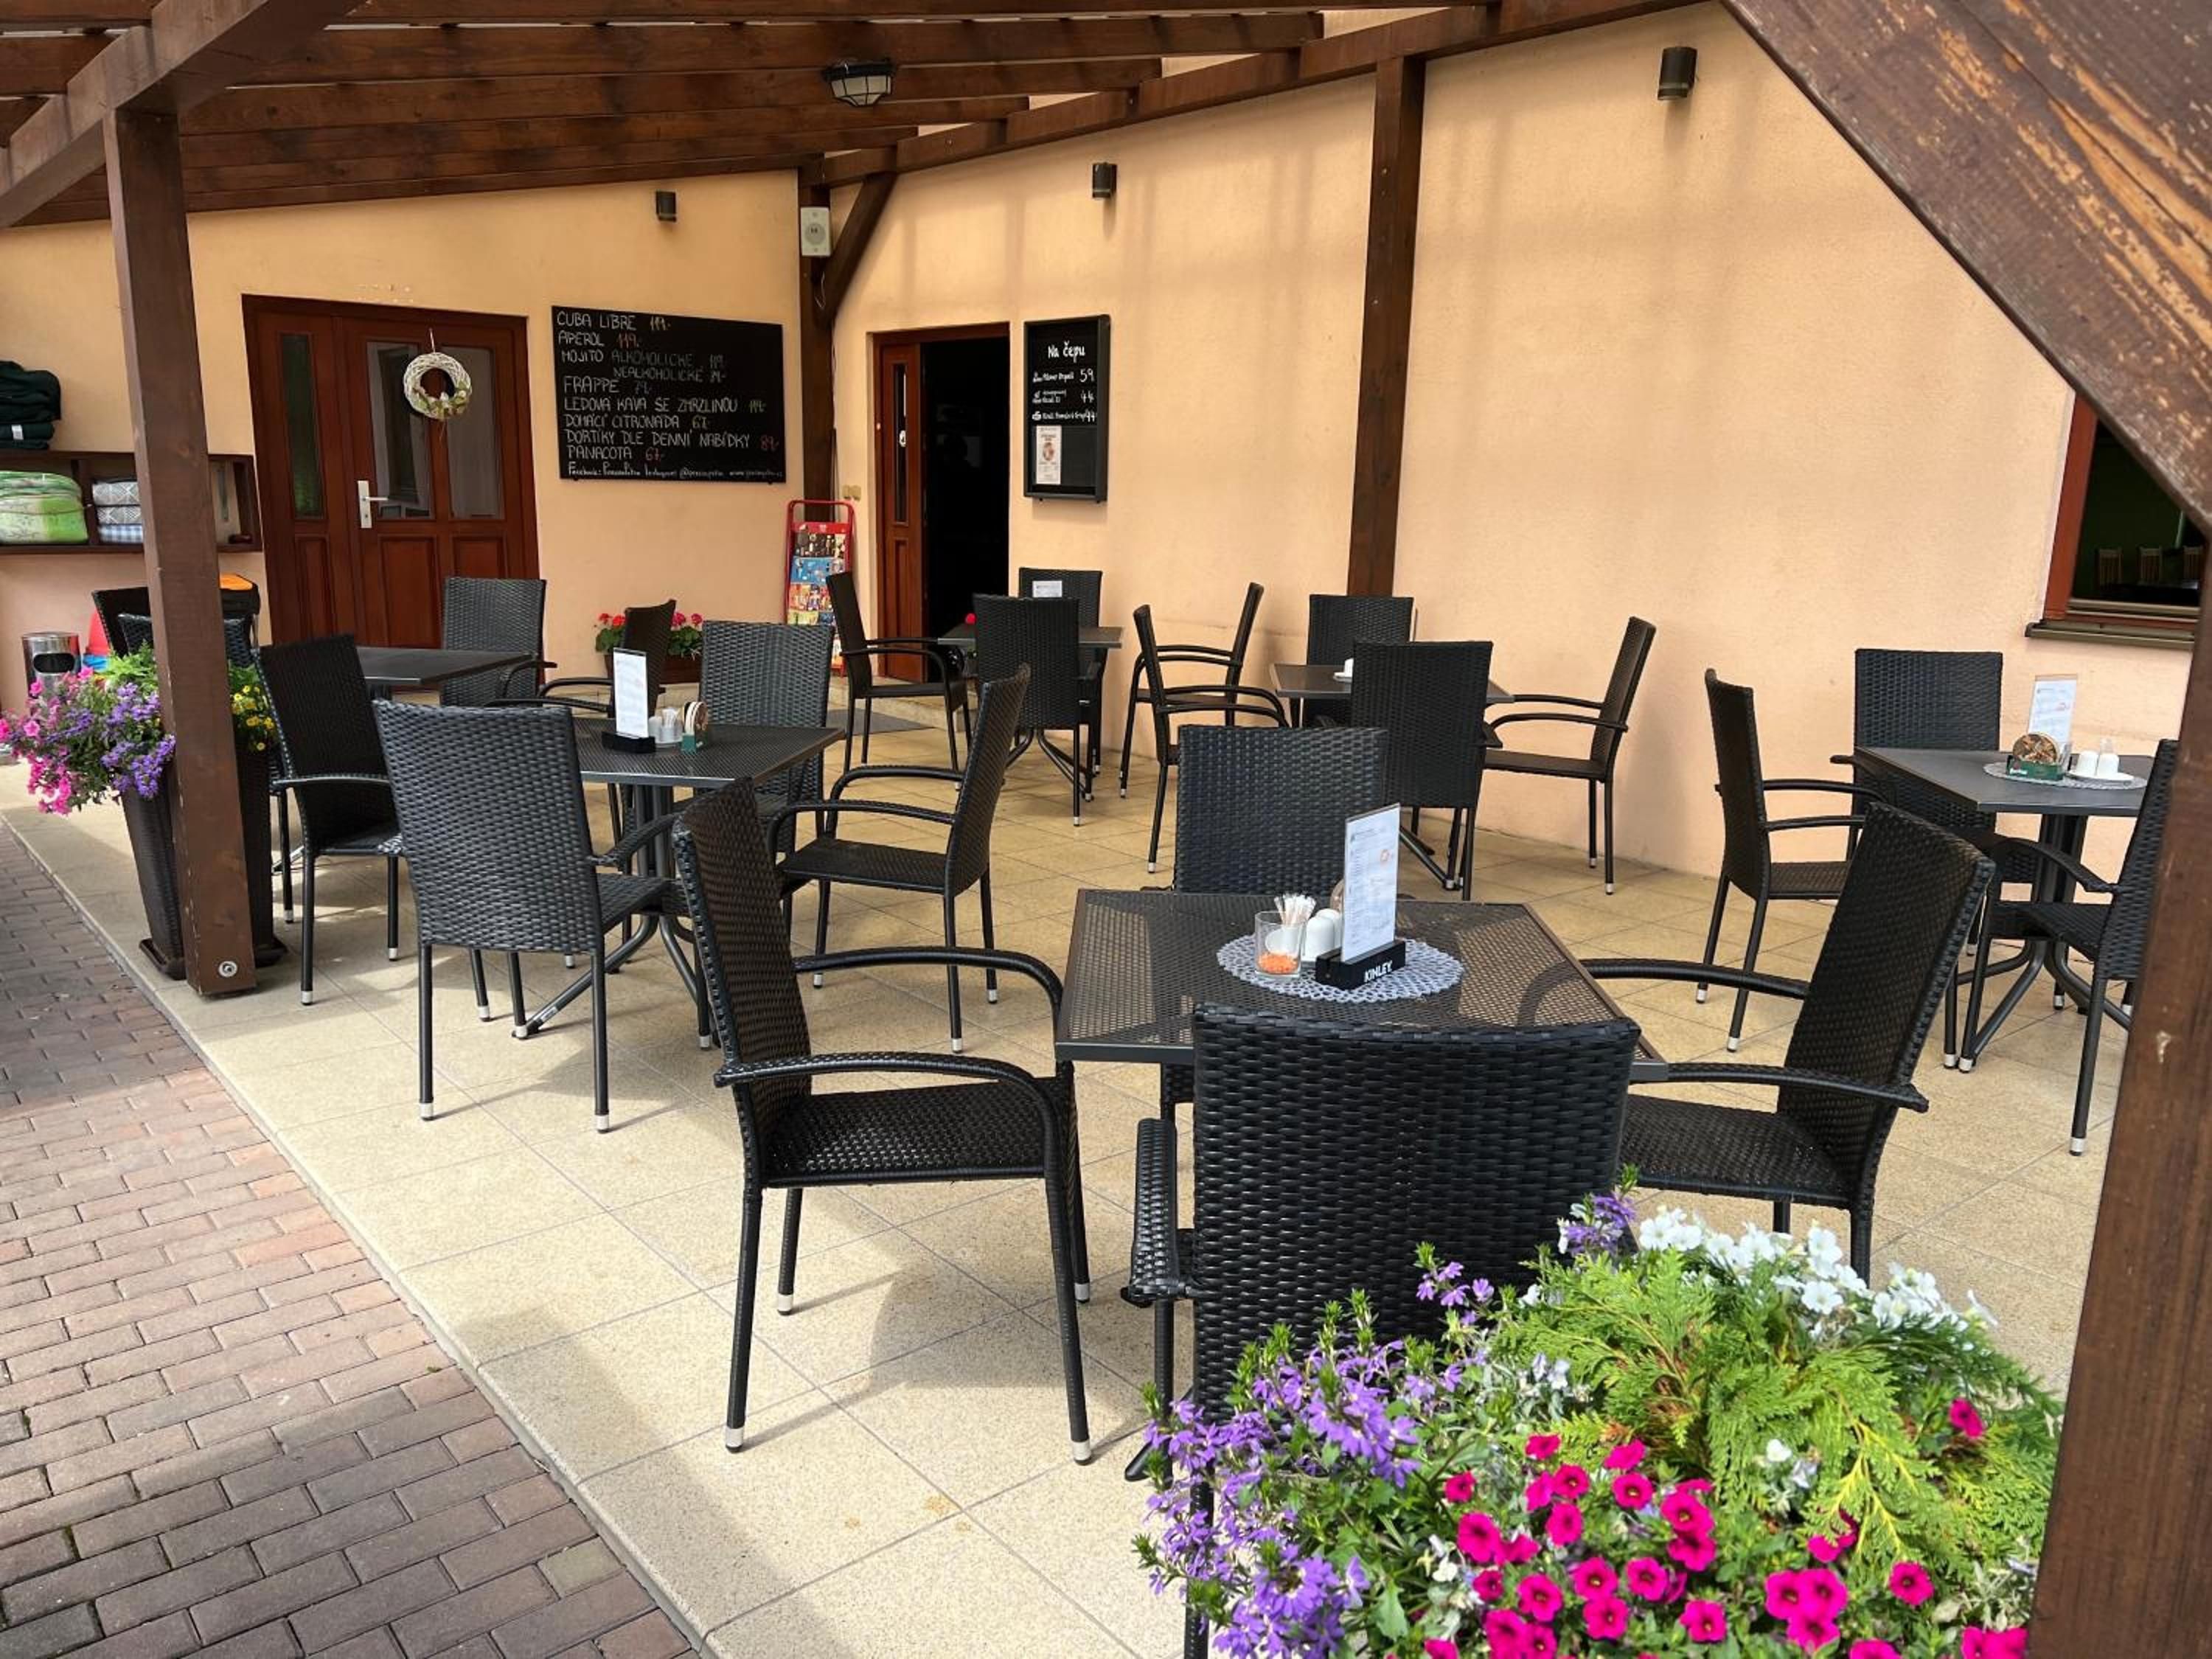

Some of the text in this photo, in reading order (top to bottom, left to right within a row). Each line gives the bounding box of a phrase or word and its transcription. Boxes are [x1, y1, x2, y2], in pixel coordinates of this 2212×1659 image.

[557, 310, 591, 327] CUBA
[599, 313, 636, 331] LIBRE
[558, 330, 605, 347] APEROL
[561, 349, 604, 364] MOJITO
[1079, 368, 1095, 383] 59
[655, 397, 670, 412] SE
[678, 397, 738, 413] ZMRZLINOU
[620, 431, 644, 445] DLE
[652, 428, 692, 447] DENNÍ
[566, 445, 632, 460] PANACOTA
